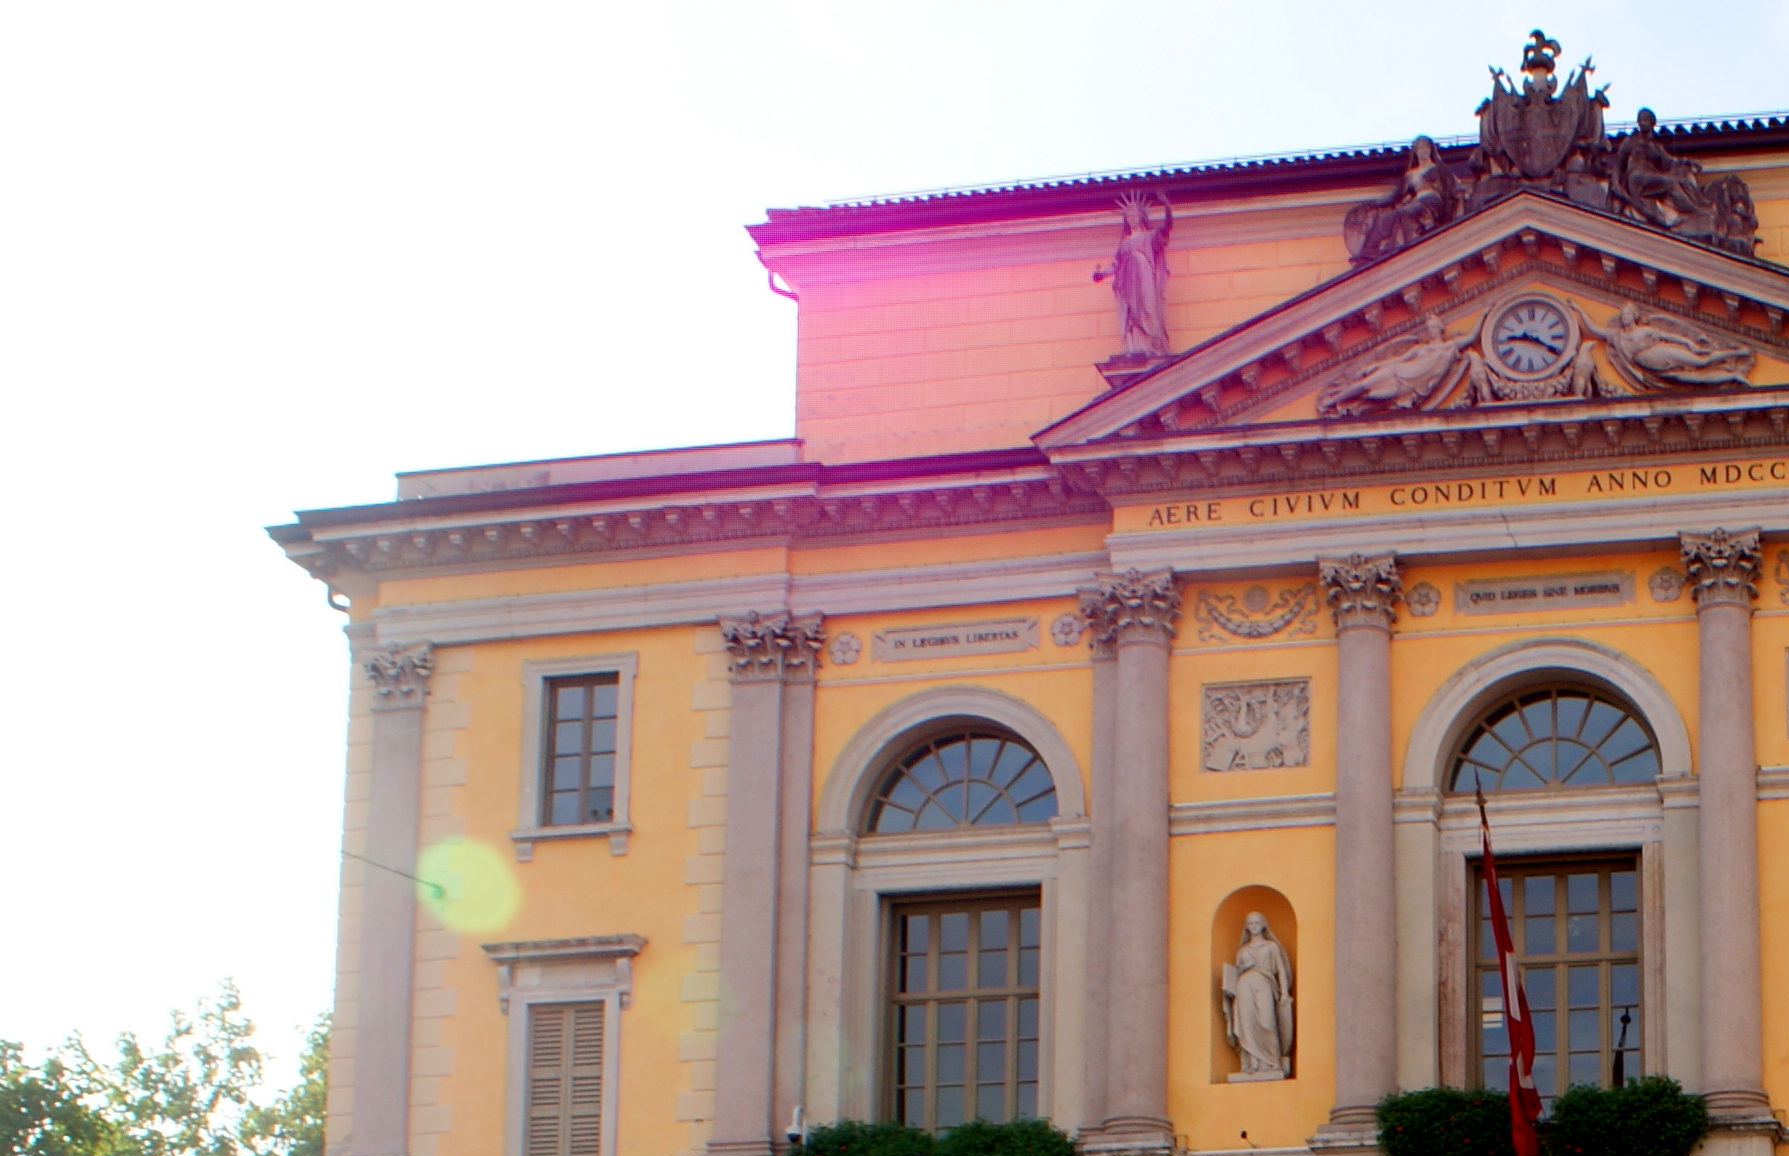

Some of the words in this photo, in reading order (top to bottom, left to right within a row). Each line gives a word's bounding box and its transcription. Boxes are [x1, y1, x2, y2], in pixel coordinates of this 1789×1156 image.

[1148, 503, 1222, 526] AERE
[1249, 492, 1360, 517] CIVIVM
[1389, 477, 1557, 505] CONDITVM
[1587, 470, 1672, 493] ANNO
